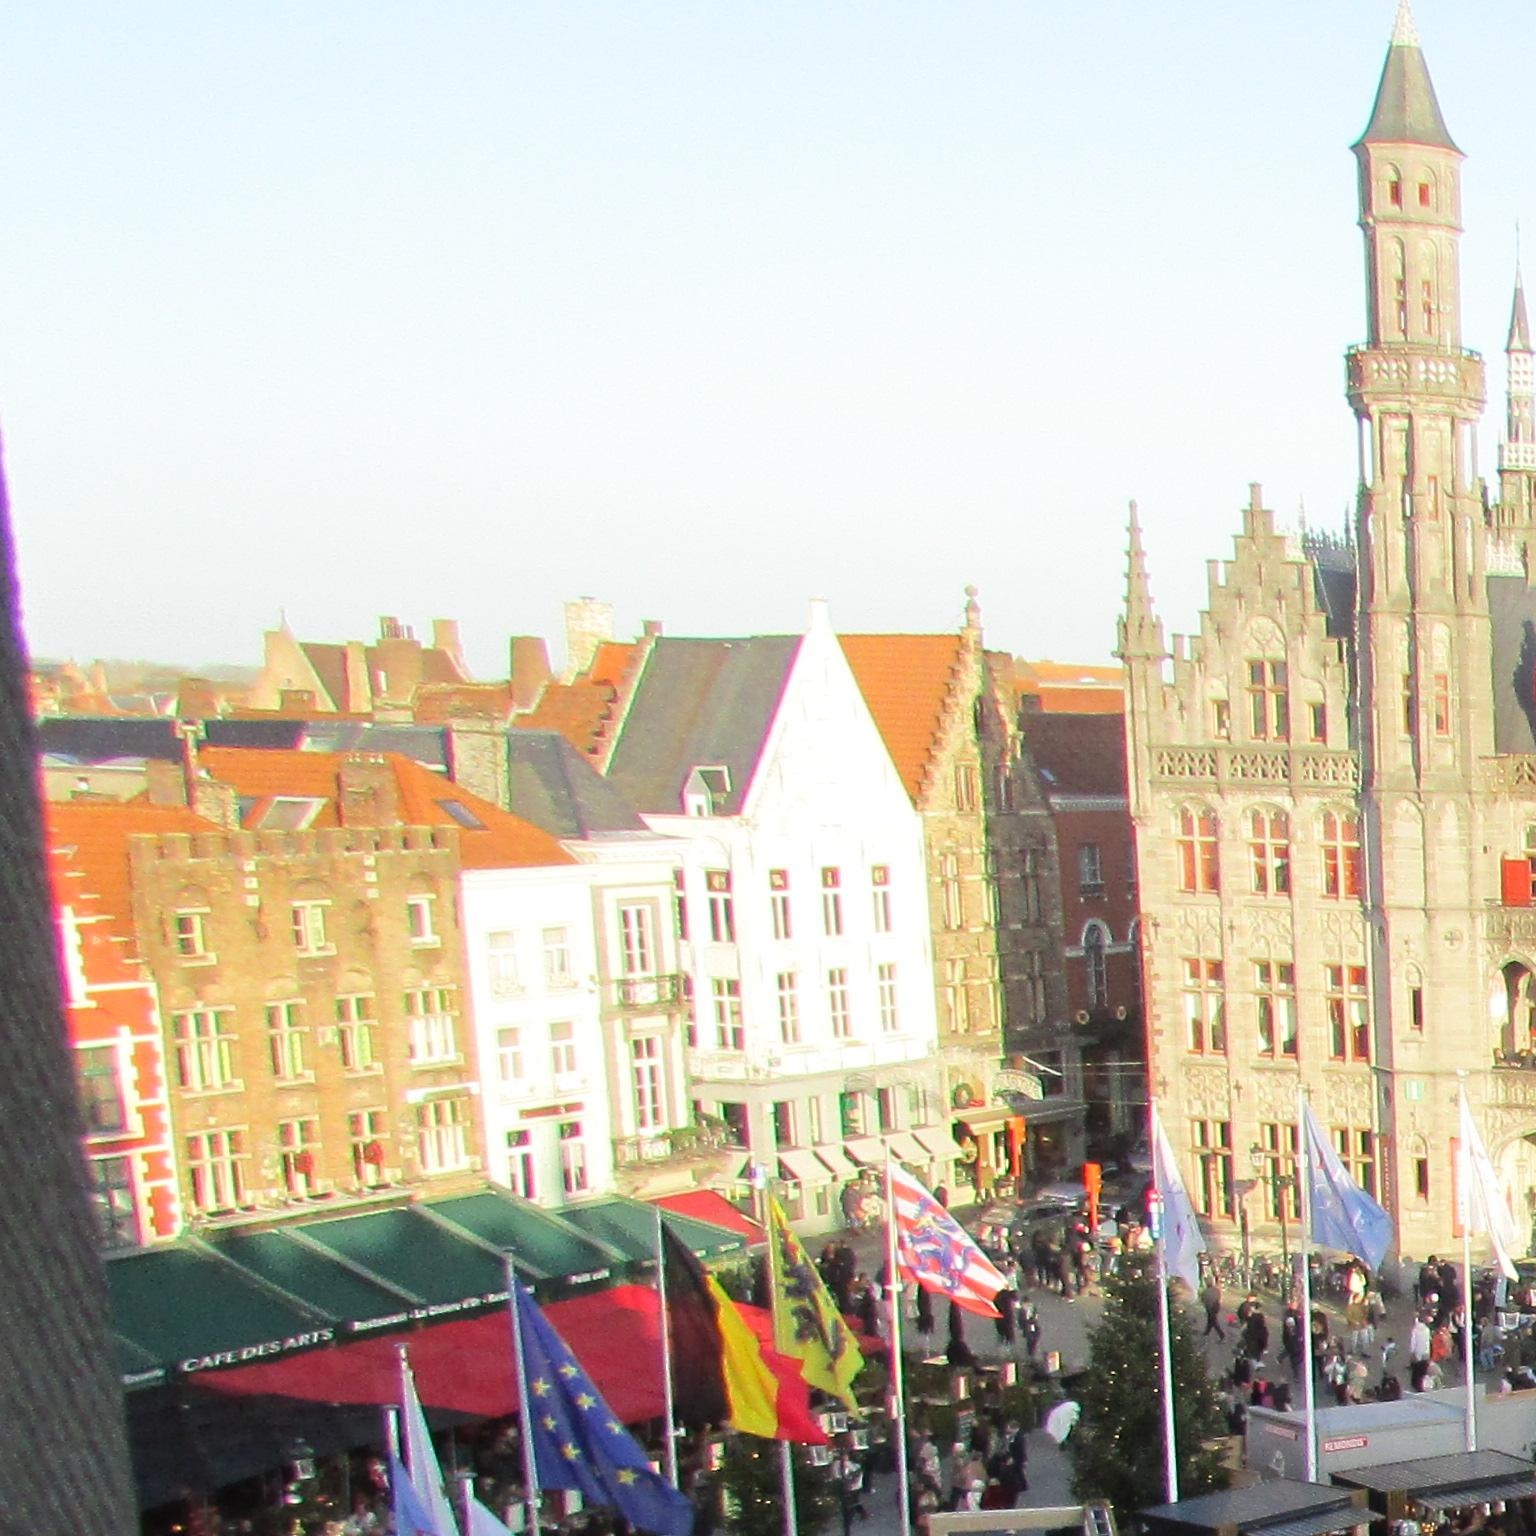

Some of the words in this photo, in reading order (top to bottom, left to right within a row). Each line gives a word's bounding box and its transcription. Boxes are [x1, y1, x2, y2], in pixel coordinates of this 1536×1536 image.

[181, 1351, 238, 1372] CAFE
[240, 1340, 281, 1360] DES
[283, 1328, 334, 1350] ARTS
